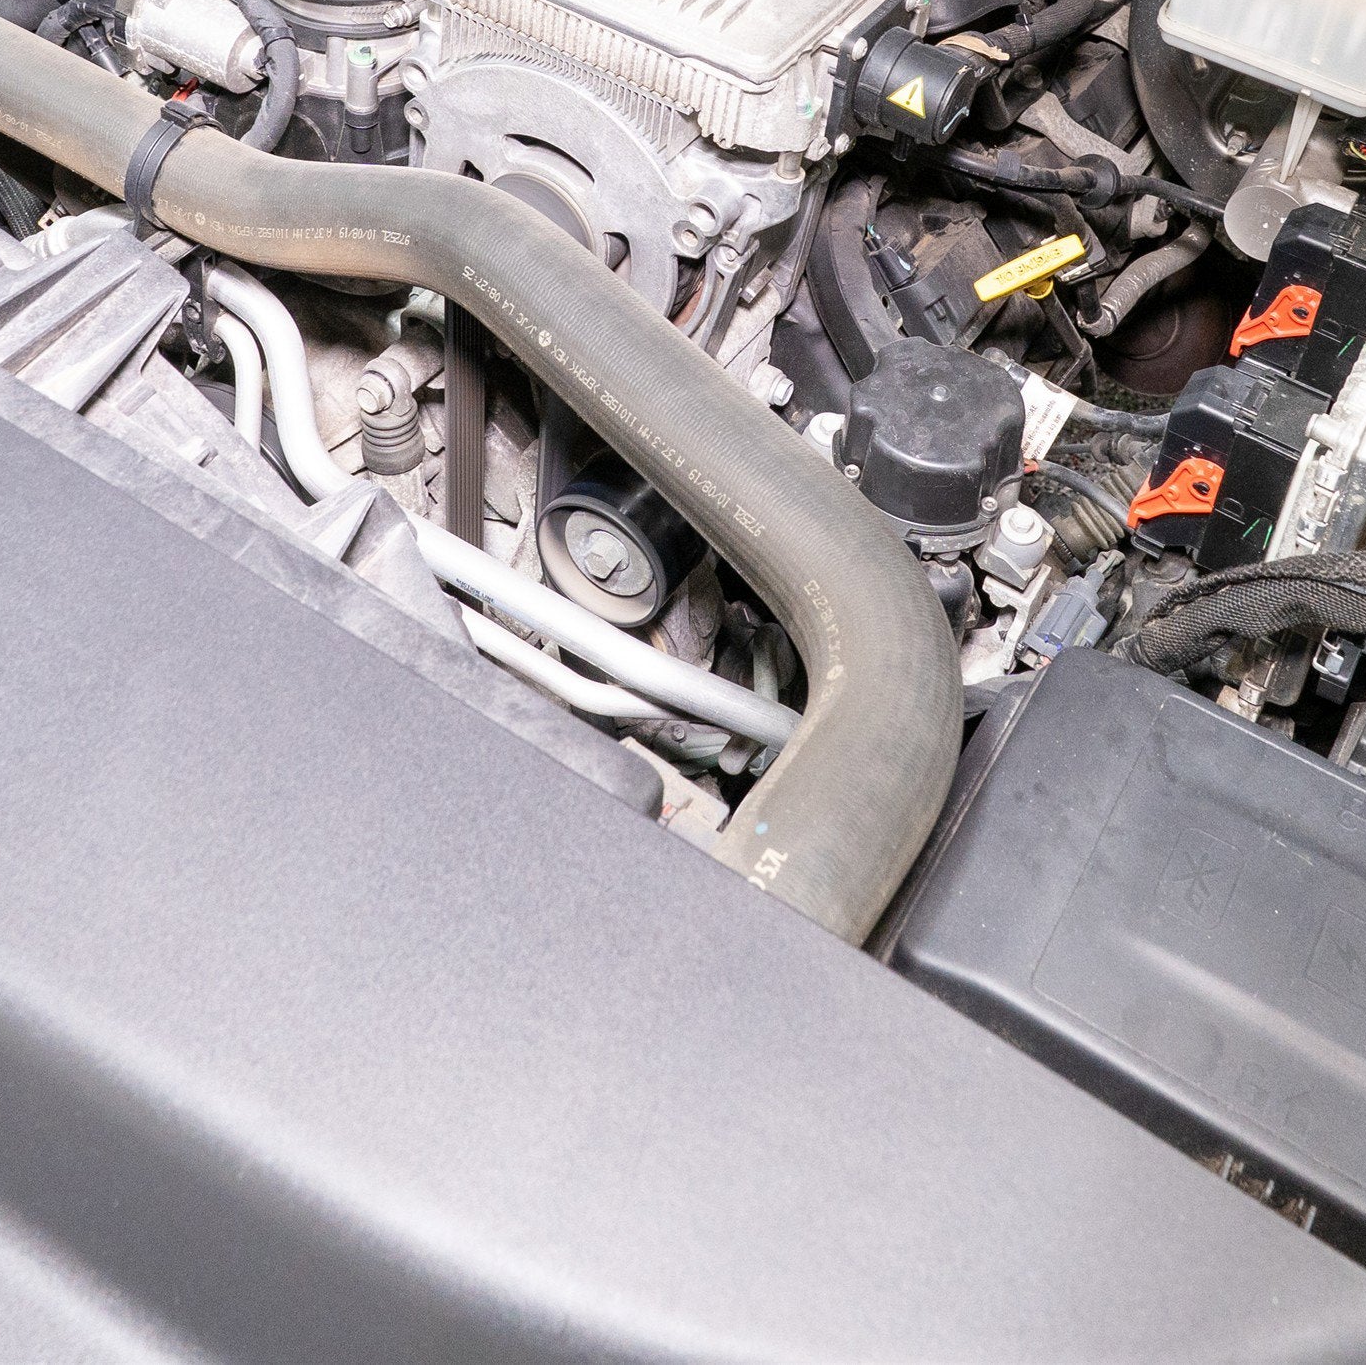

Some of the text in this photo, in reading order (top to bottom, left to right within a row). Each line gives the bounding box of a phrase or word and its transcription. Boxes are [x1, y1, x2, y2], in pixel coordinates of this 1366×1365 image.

[305, 226, 324, 238] 37.3
[339, 227, 376, 239] 10/08/19
[1016, 246, 1063, 275] ENGINE
[459, 264, 504, 304] 08:27:25
[547, 343, 571, 367] MEX
[598, 389, 639, 428] 1101582
[634, 422, 655, 442] MM
[648, 434, 678, 461] 37.3
[685, 467, 733, 509] 10/08/19
[729, 504, 766, 539] 97252L
